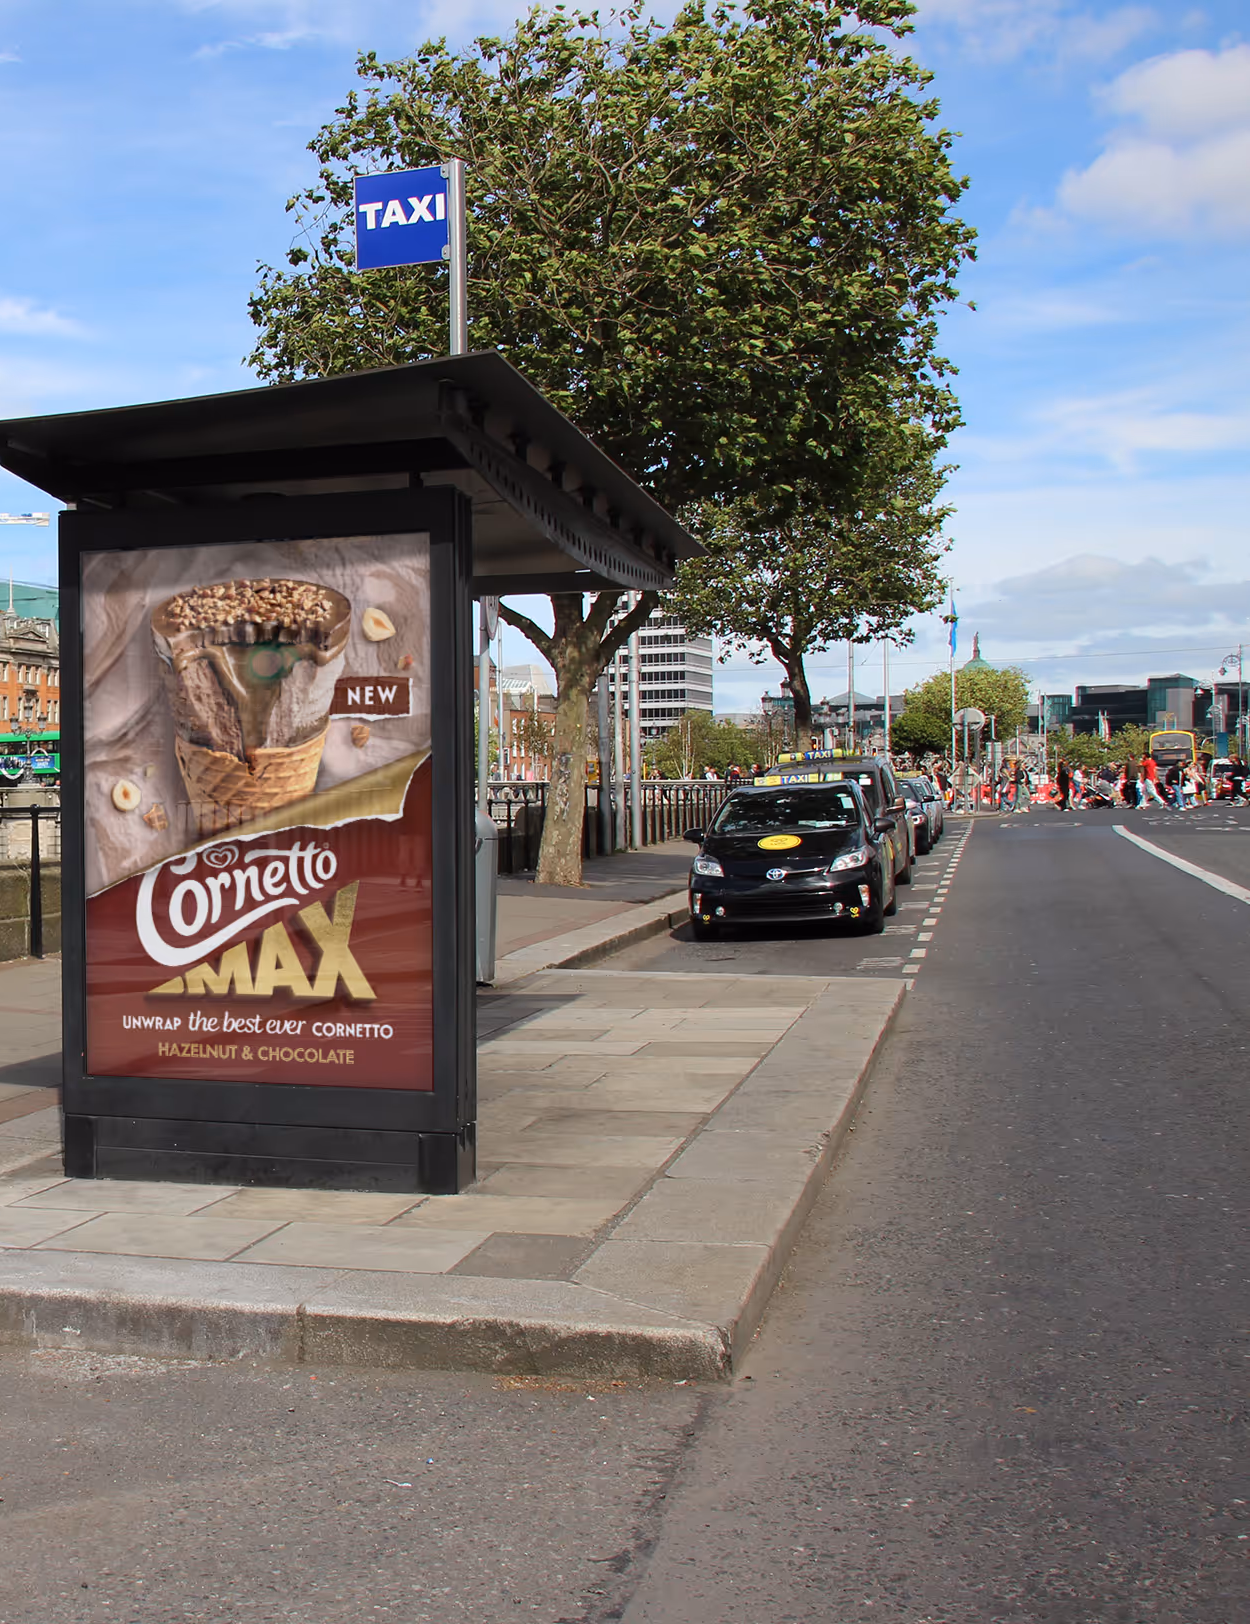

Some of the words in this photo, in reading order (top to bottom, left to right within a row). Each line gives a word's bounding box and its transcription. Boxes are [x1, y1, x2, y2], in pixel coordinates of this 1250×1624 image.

[358, 193, 446, 230] TAXI
[347, 685, 398, 706] NEW
[808, 750, 831, 760] TAXI
[782, 774, 808, 784] TAXI
[136, 841, 338, 967] Cornetto
[148, 880, 378, 999] MAX
[122, 1015, 182, 1031] UNWRAP
[188, 1010, 220, 1032] the
[223, 1011, 264, 1034] best
[266, 1020, 306, 1035] ever
[312, 1021, 394, 1039] CORNETTO
[158, 1042, 238, 1060] HAZELNUT
[241, 1046, 255, 1060] &
[258, 1046, 355, 1065] CHOCOLATE
